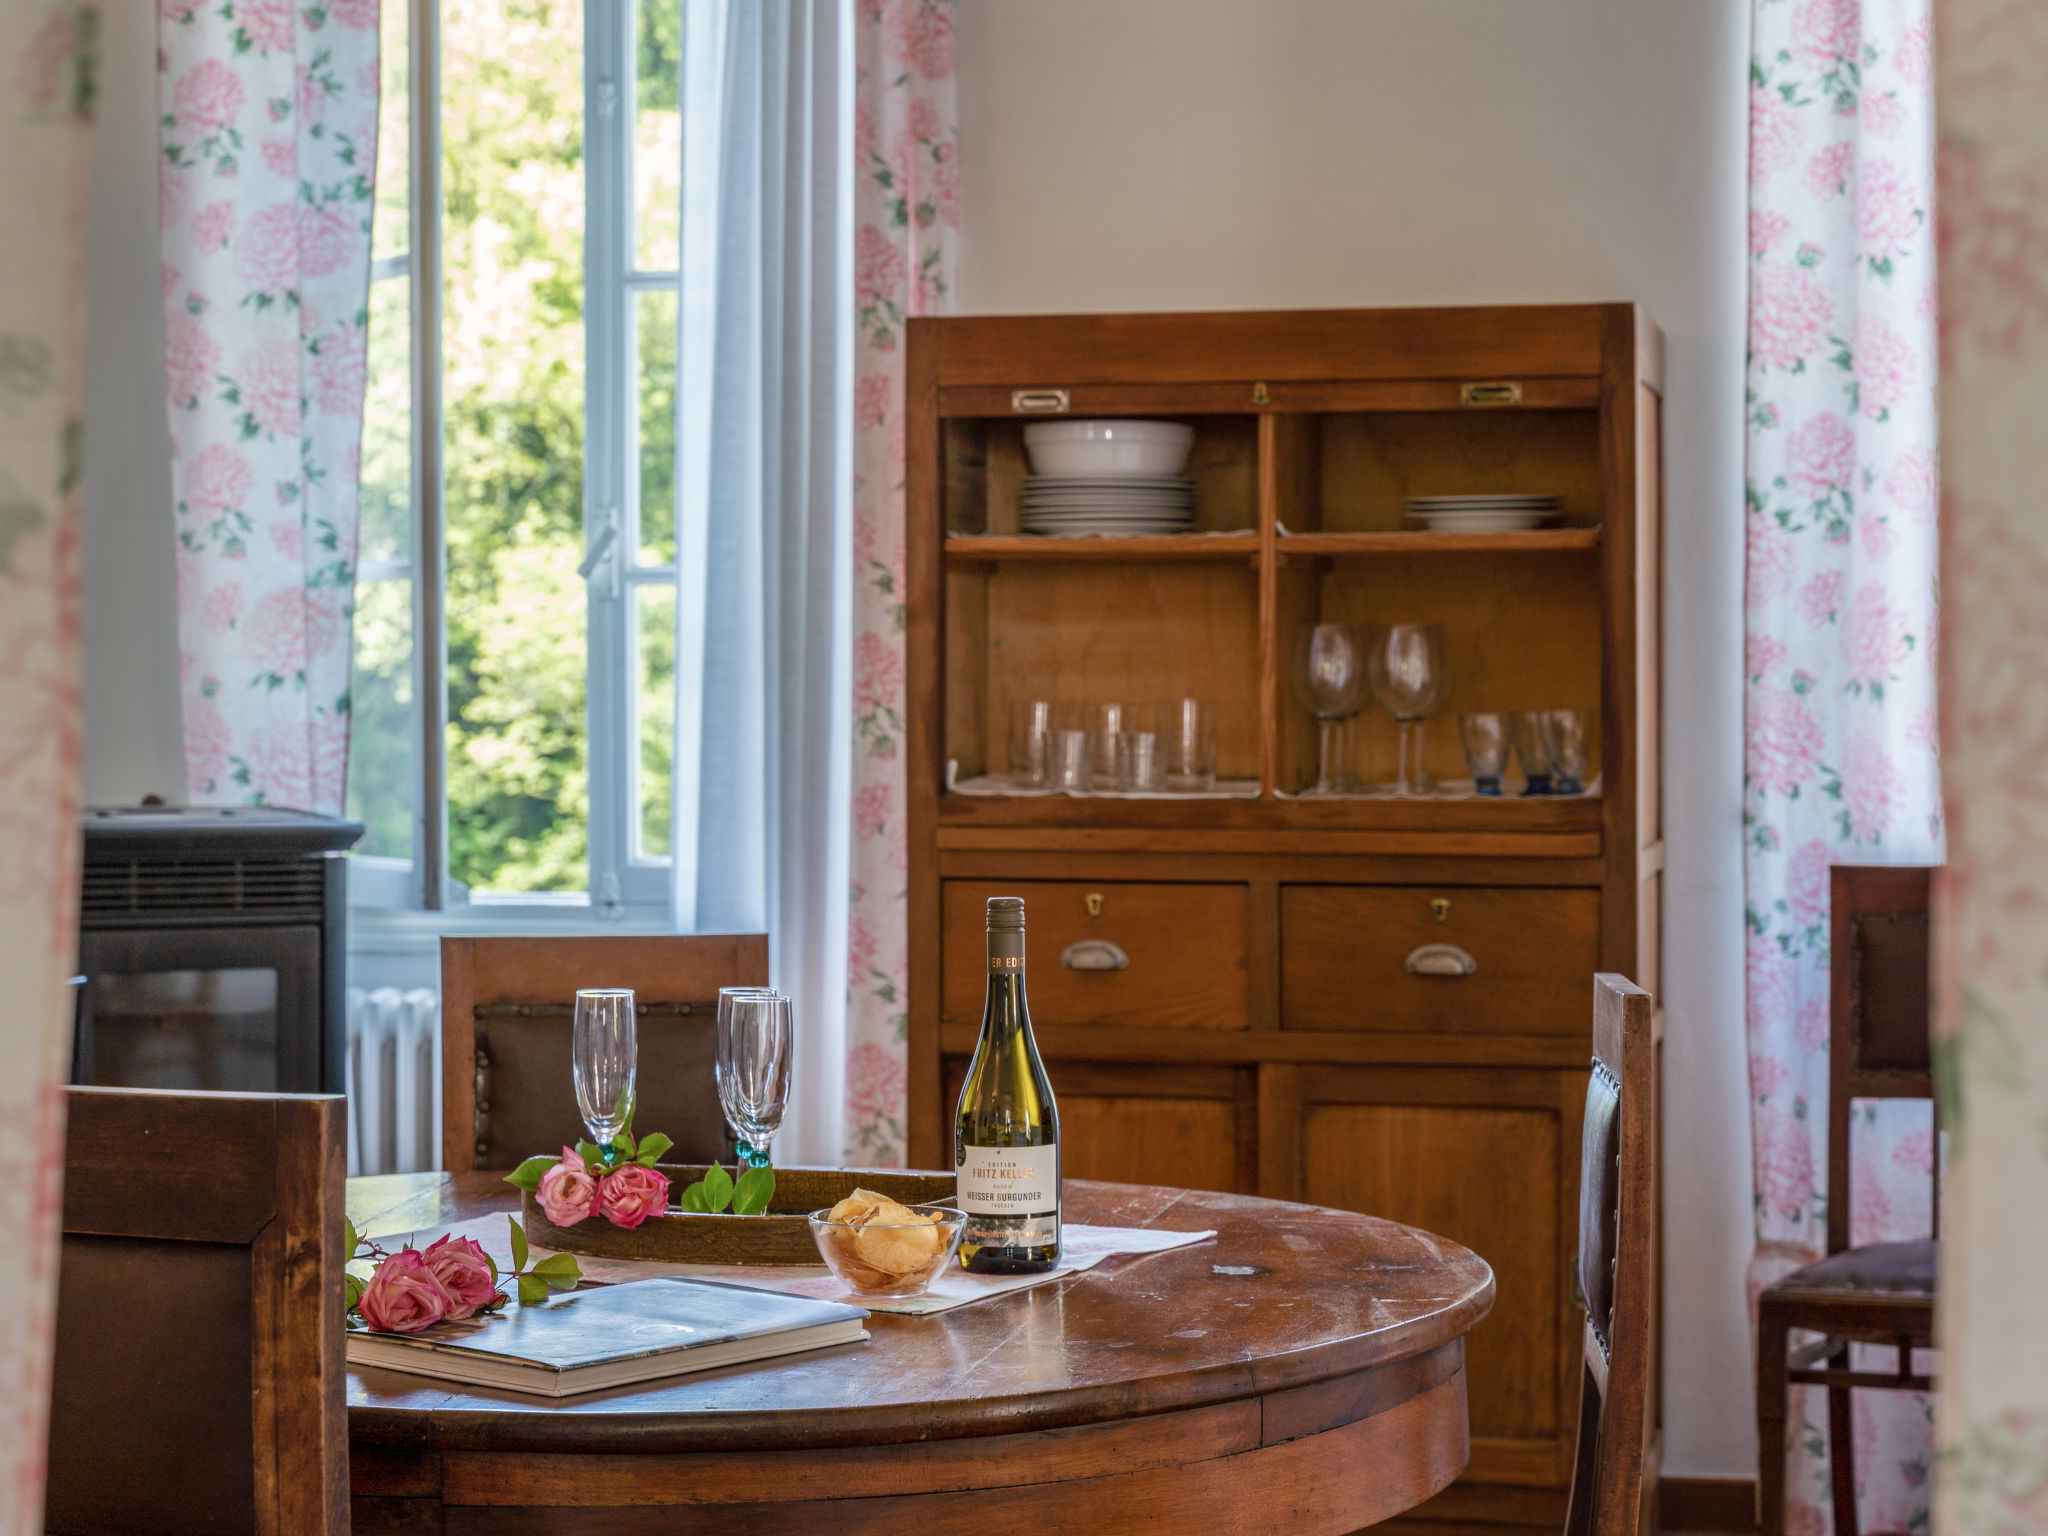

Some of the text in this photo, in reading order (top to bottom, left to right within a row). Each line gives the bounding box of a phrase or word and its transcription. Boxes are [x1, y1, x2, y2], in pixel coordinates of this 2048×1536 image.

[972, 1168, 997, 1179] FRITZ
[967, 1191, 1042, 1202] WEISSER BURGUNDER
